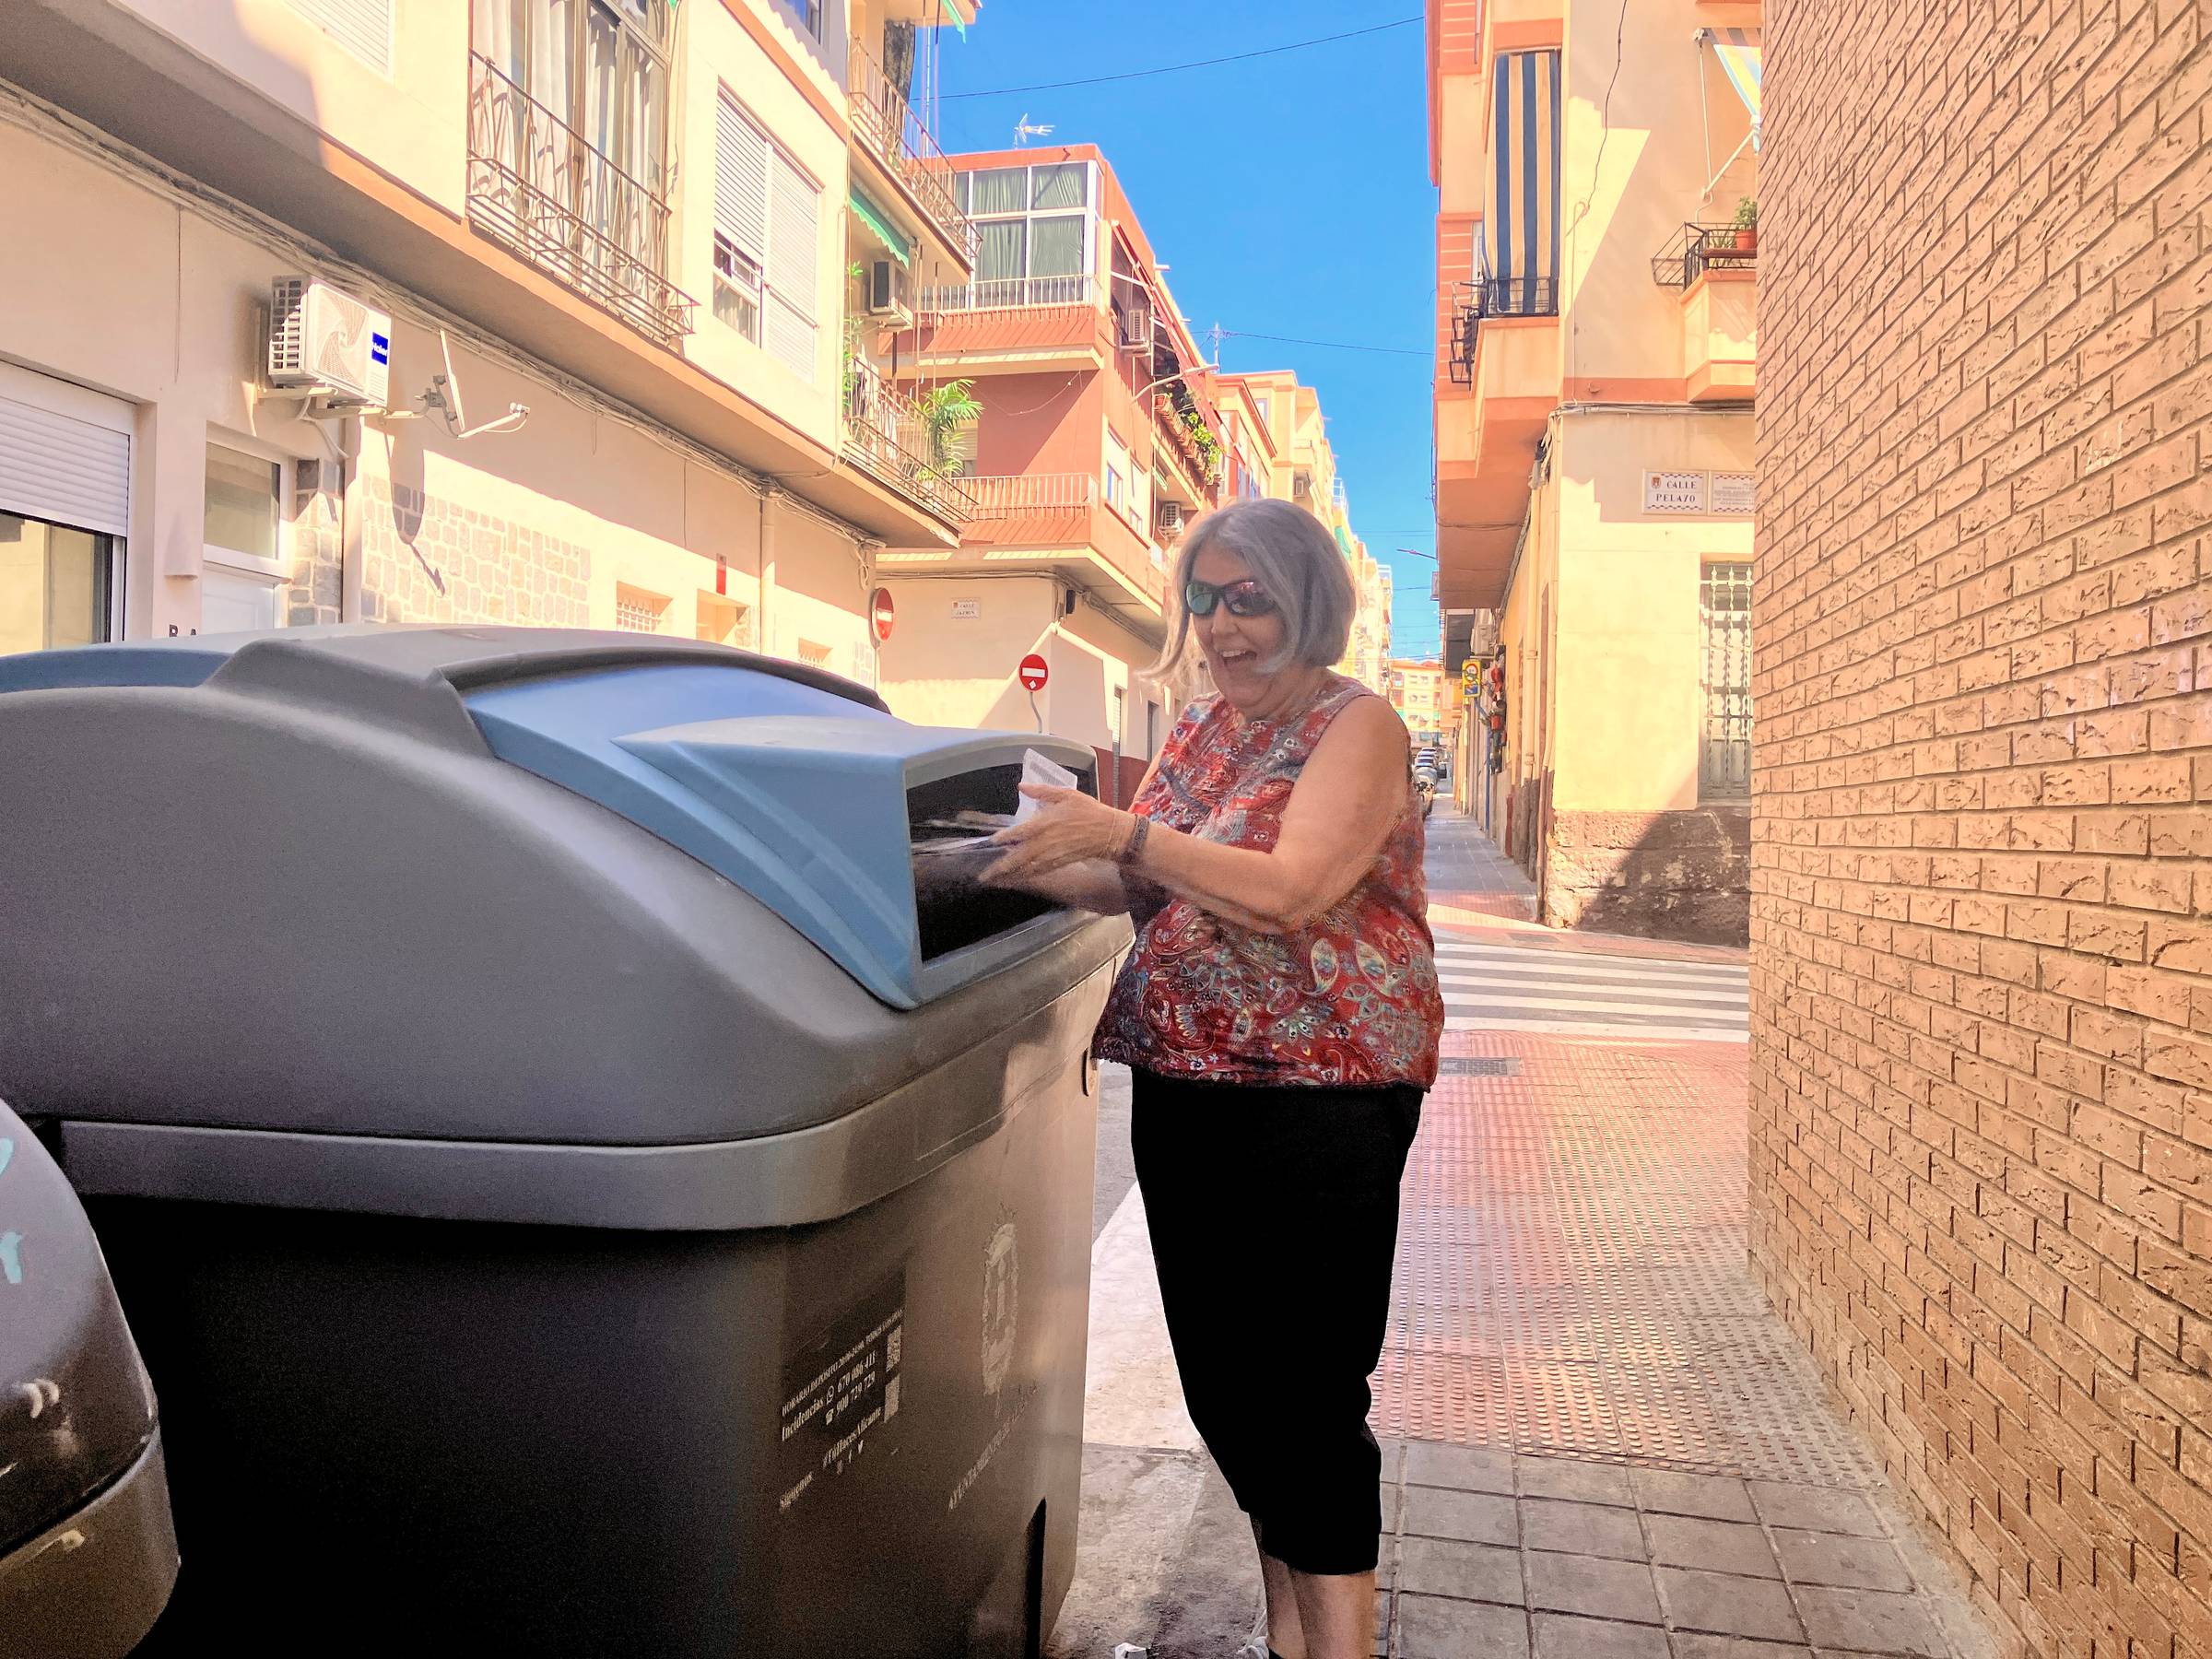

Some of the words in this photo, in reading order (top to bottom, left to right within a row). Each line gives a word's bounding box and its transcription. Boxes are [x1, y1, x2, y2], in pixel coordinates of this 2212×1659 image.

[372, 342, 388, 357] Haier
[1666, 480, 1696, 488] CALLE
[782, 1396, 824, 1442] Incidencias
[837, 1371, 851, 1393] 670
